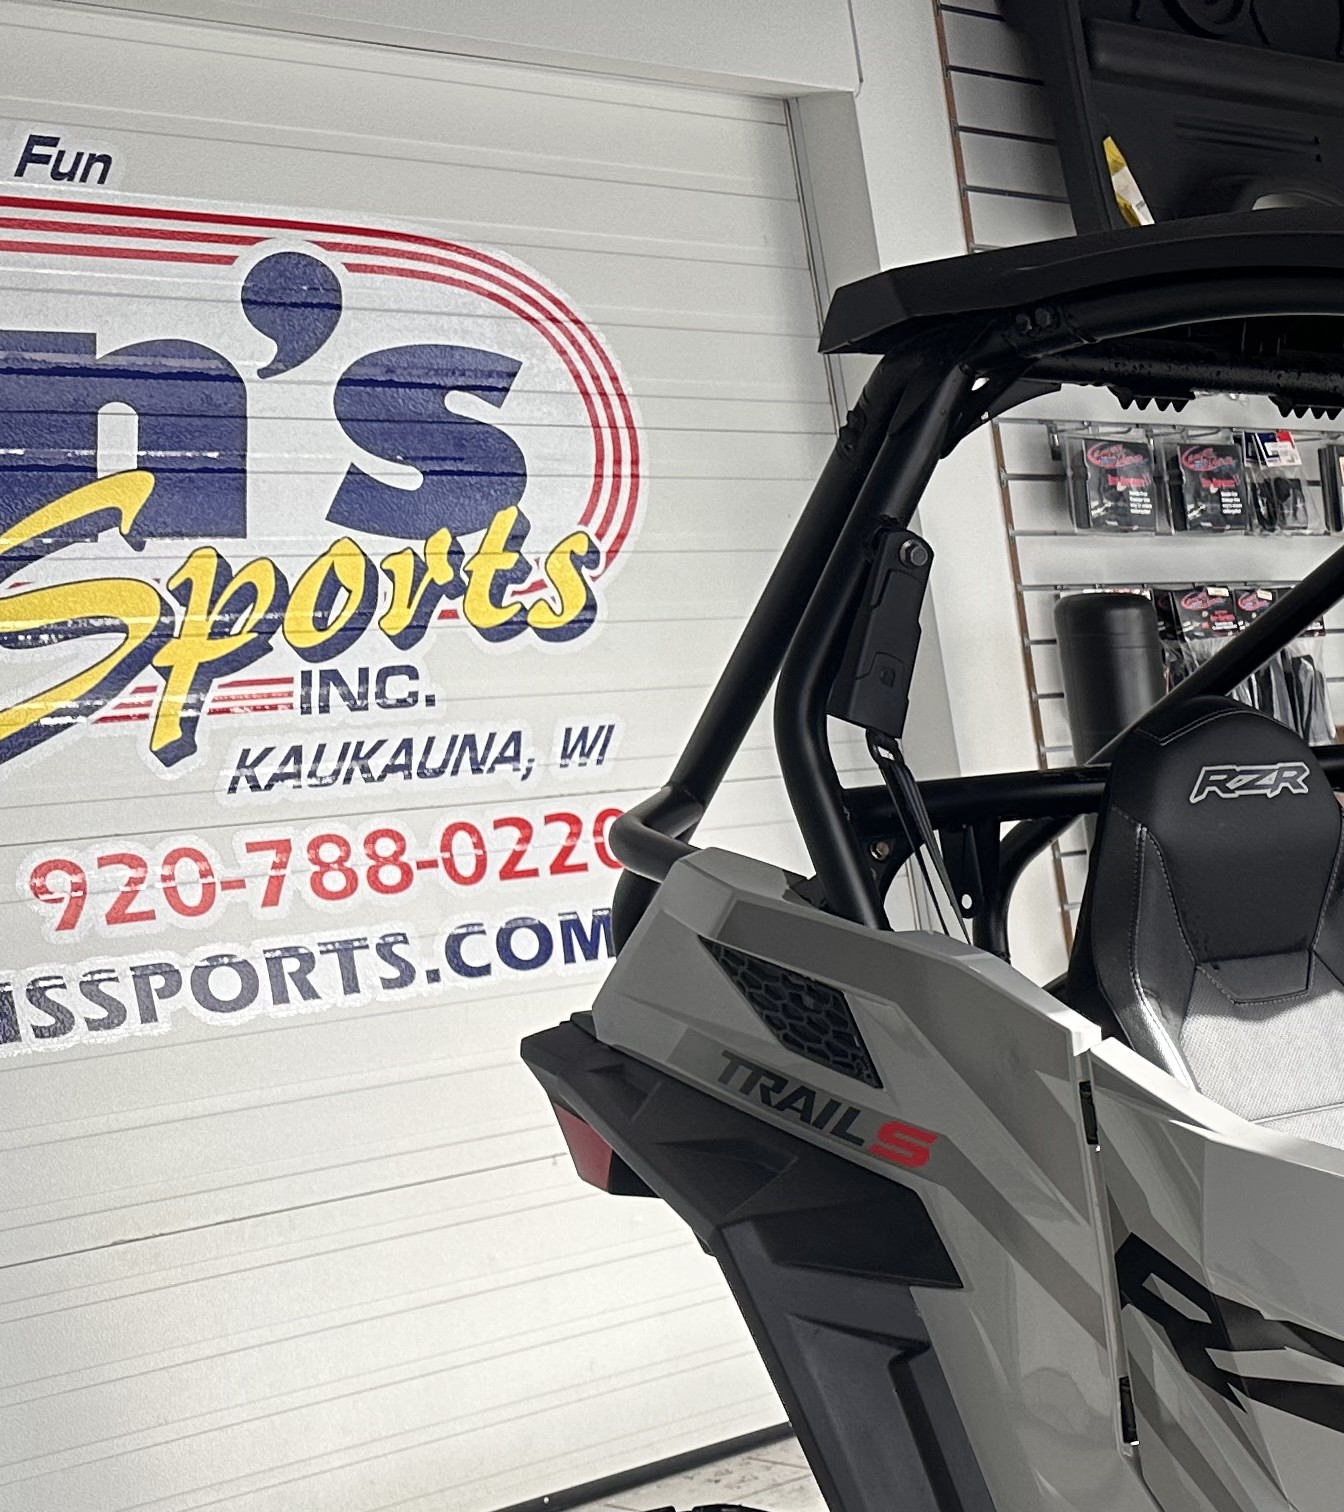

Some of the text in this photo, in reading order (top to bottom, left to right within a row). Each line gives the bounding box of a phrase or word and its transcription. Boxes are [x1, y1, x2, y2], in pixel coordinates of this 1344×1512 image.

[14, 134, 112, 185] Fun
[0, 470, 604, 767] Sports
[301, 664, 436, 715] INC.
[227, 724, 616, 796] KAUKAUNA, WI
[1189, 771, 1310, 804] RZR
[28, 807, 628, 932] 920-788-0220
[717, 1050, 939, 1169] TRAIL S
